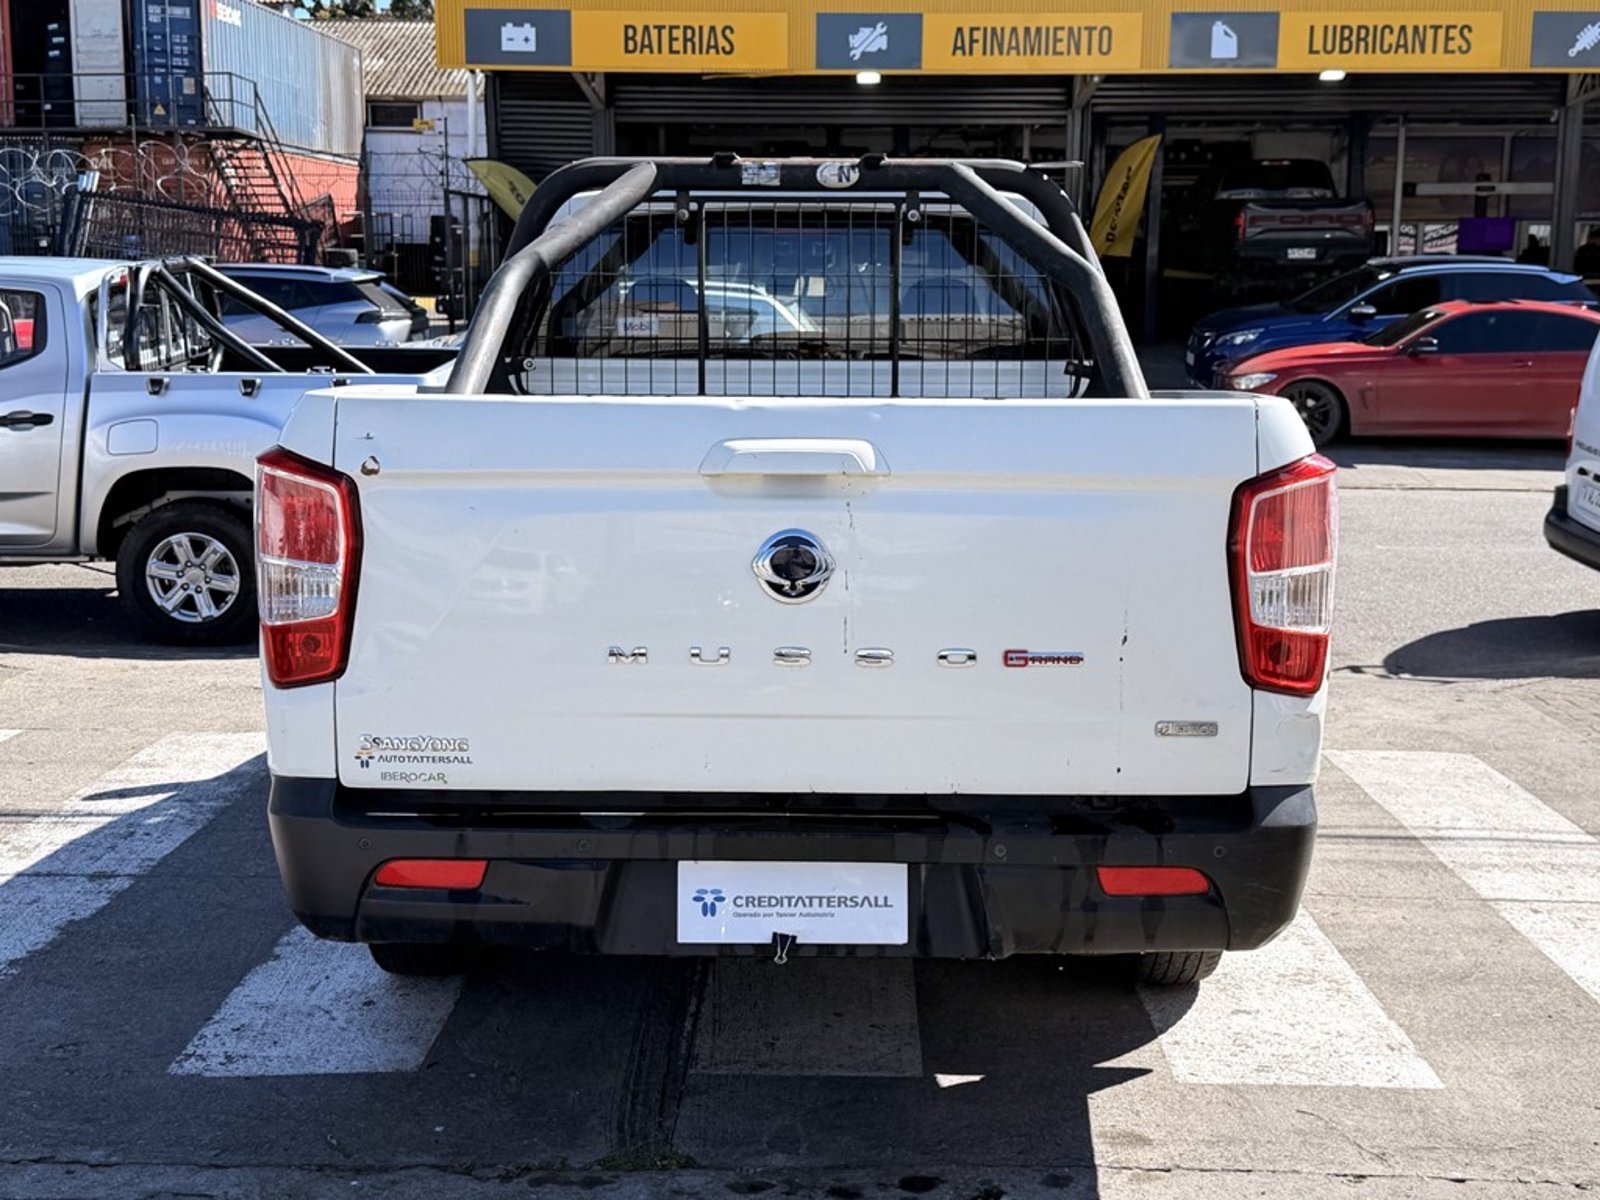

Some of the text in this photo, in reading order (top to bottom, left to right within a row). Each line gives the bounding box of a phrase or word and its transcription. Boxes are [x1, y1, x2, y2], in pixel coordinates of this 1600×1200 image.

[623, 24, 735, 55] BATERIAS
[951, 26, 1113, 56] AFINAMIENTO
[1308, 24, 1473, 55] LUBRICANTES
[607, 646, 978, 669] MUSSO
[377, 754, 474, 765] AUTOTATTERSALL
[380, 771, 448, 784] IBEROCAR
[732, 895, 894, 909] CREDITATTERSALL
